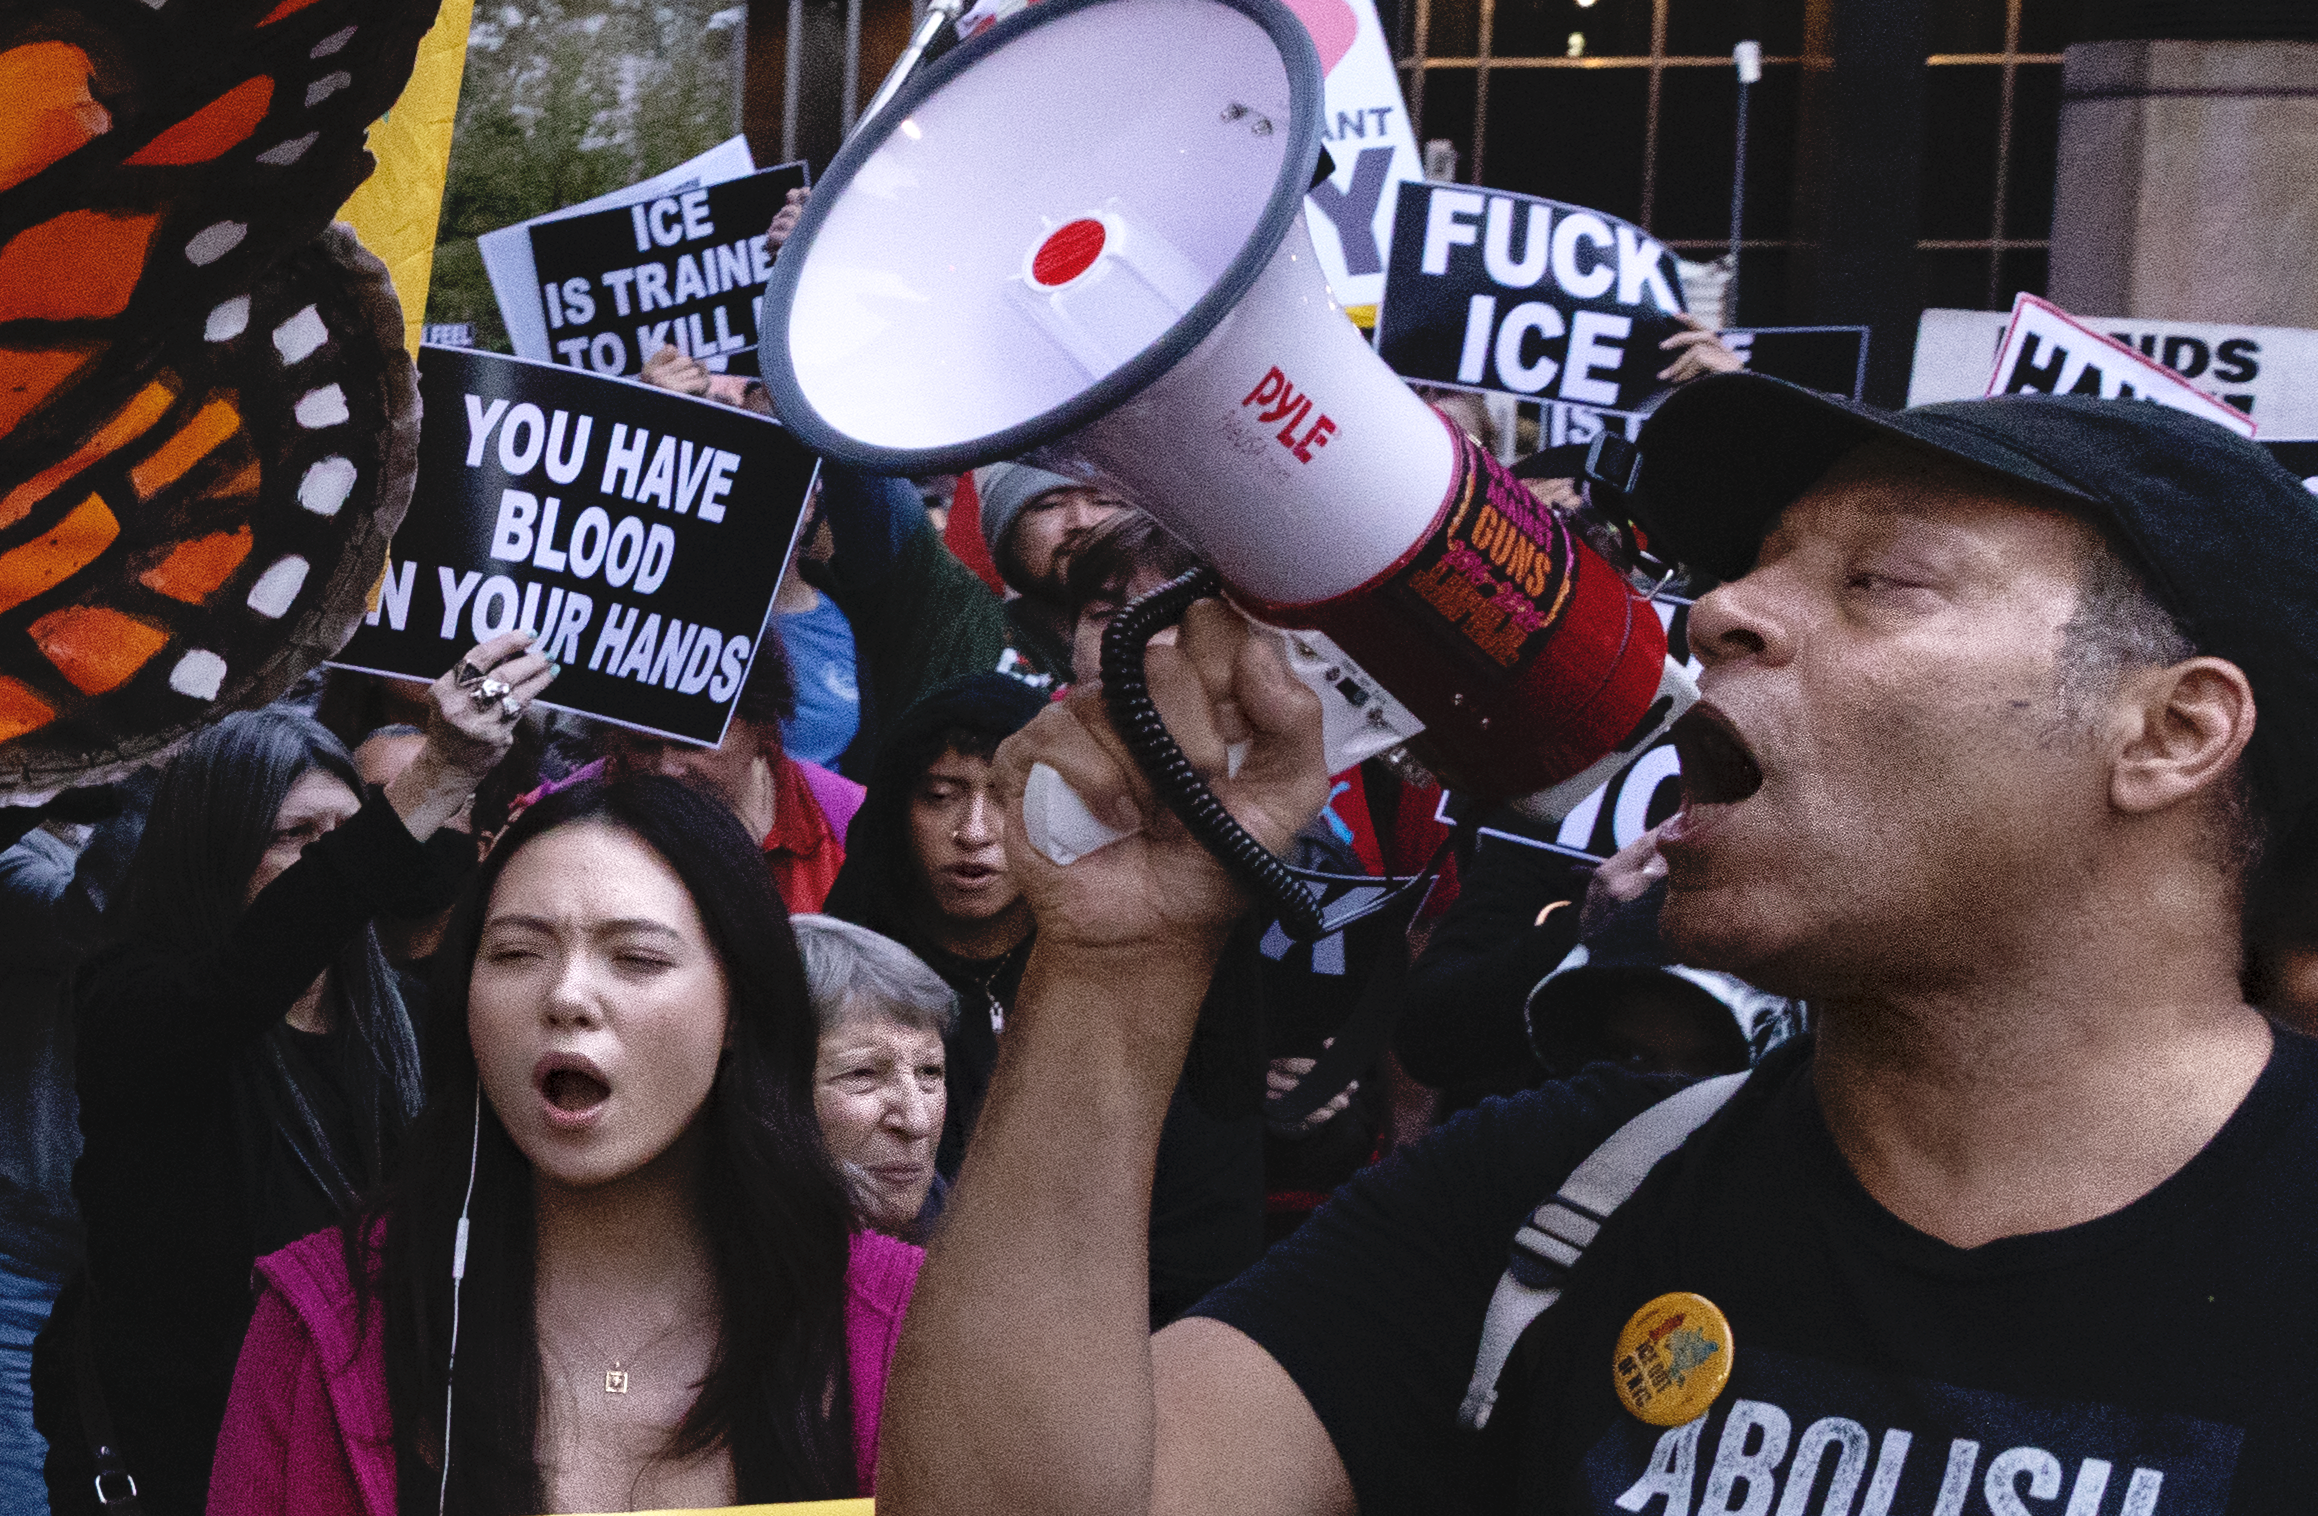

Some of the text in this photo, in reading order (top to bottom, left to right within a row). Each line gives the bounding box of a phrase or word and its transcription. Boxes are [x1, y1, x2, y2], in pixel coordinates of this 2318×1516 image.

[631, 188, 714, 253] ICE
[1422, 188, 1686, 314] FUCK
[545, 276, 596, 330] IS
[601, 234, 776, 317] TRAINE
[556, 331, 627, 377] TO
[635, 305, 746, 363] KILL
[1457, 294, 1632, 406] ICE
[464, 393, 741, 523] YOU HAVE
[1242, 365, 1337, 465] PYLE
[490, 487, 675, 595] BLOOD
[1471, 504, 1552, 598] GUNS
[366, 560, 751, 704] N YOUR HANDS
